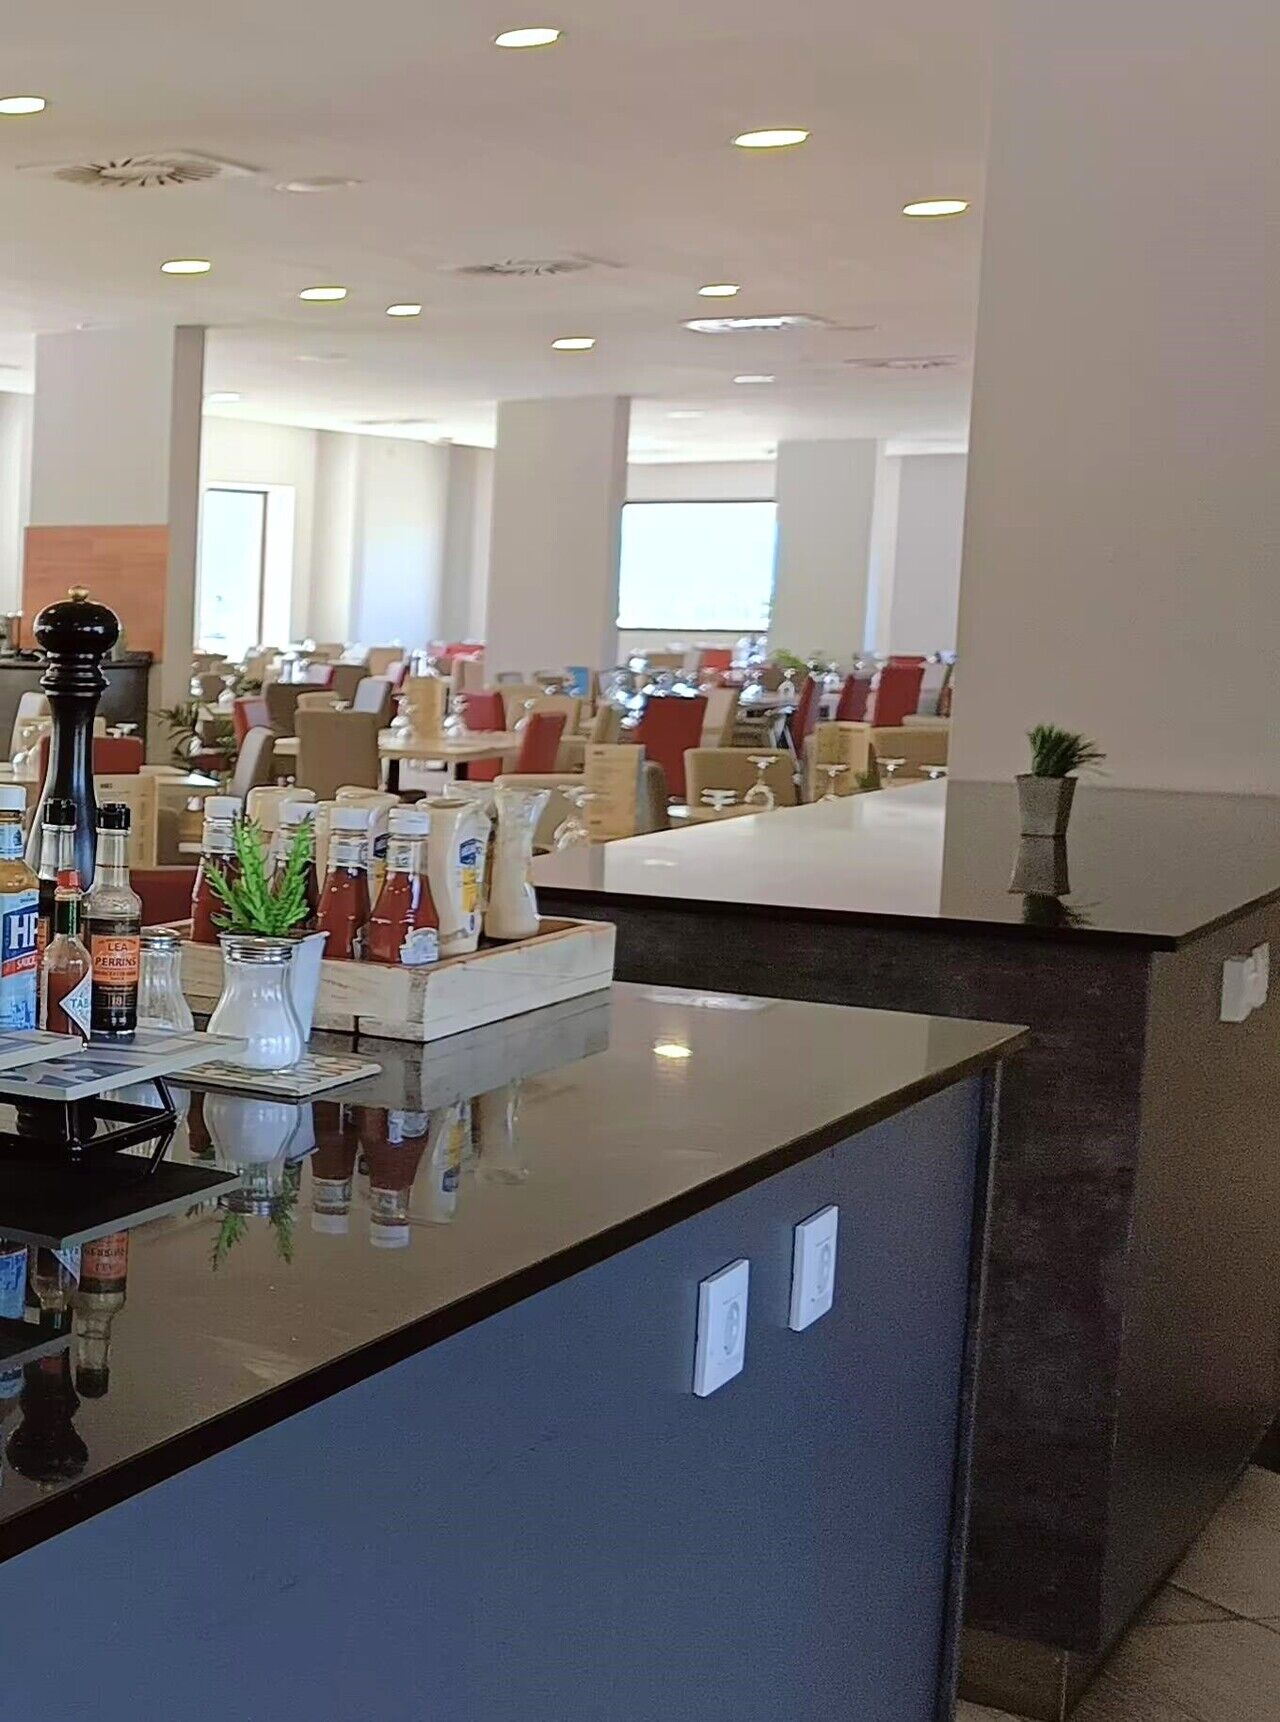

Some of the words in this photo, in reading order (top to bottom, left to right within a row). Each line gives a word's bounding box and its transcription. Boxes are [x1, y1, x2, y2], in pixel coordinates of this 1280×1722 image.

[9, 911, 39, 950] HP
[107, 942, 128, 952] LEA
[94, 957, 137, 967] PERRINS
